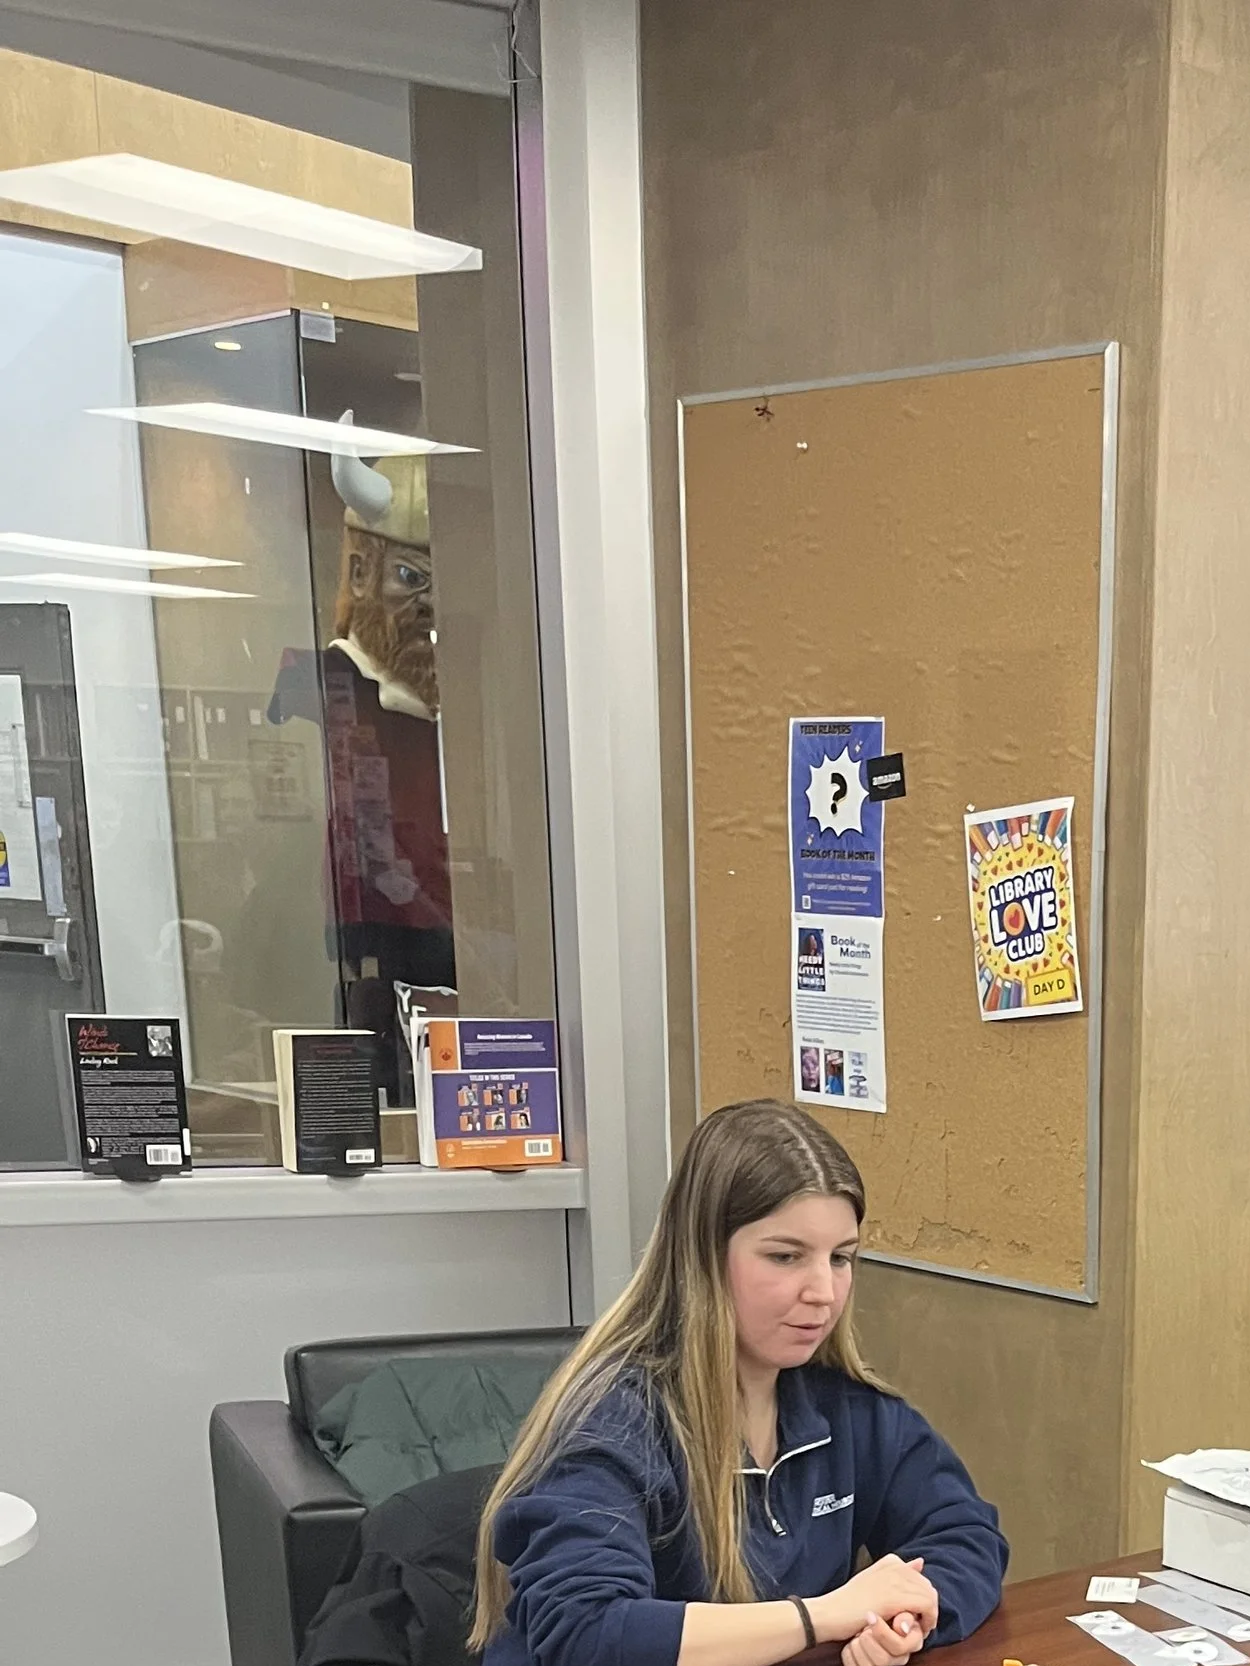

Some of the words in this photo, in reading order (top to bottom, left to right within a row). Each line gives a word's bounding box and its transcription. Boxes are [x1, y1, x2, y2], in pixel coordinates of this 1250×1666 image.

[989, 866, 1054, 907] LIBRARY
[990, 891, 1057, 944] LOVE
[830, 935, 856, 946] Book
[1008, 933, 1044, 960] CLUB
[840, 947, 871, 959] Month
[1033, 982, 1054, 996] DAY
[1056, 979, 1065, 990] D
